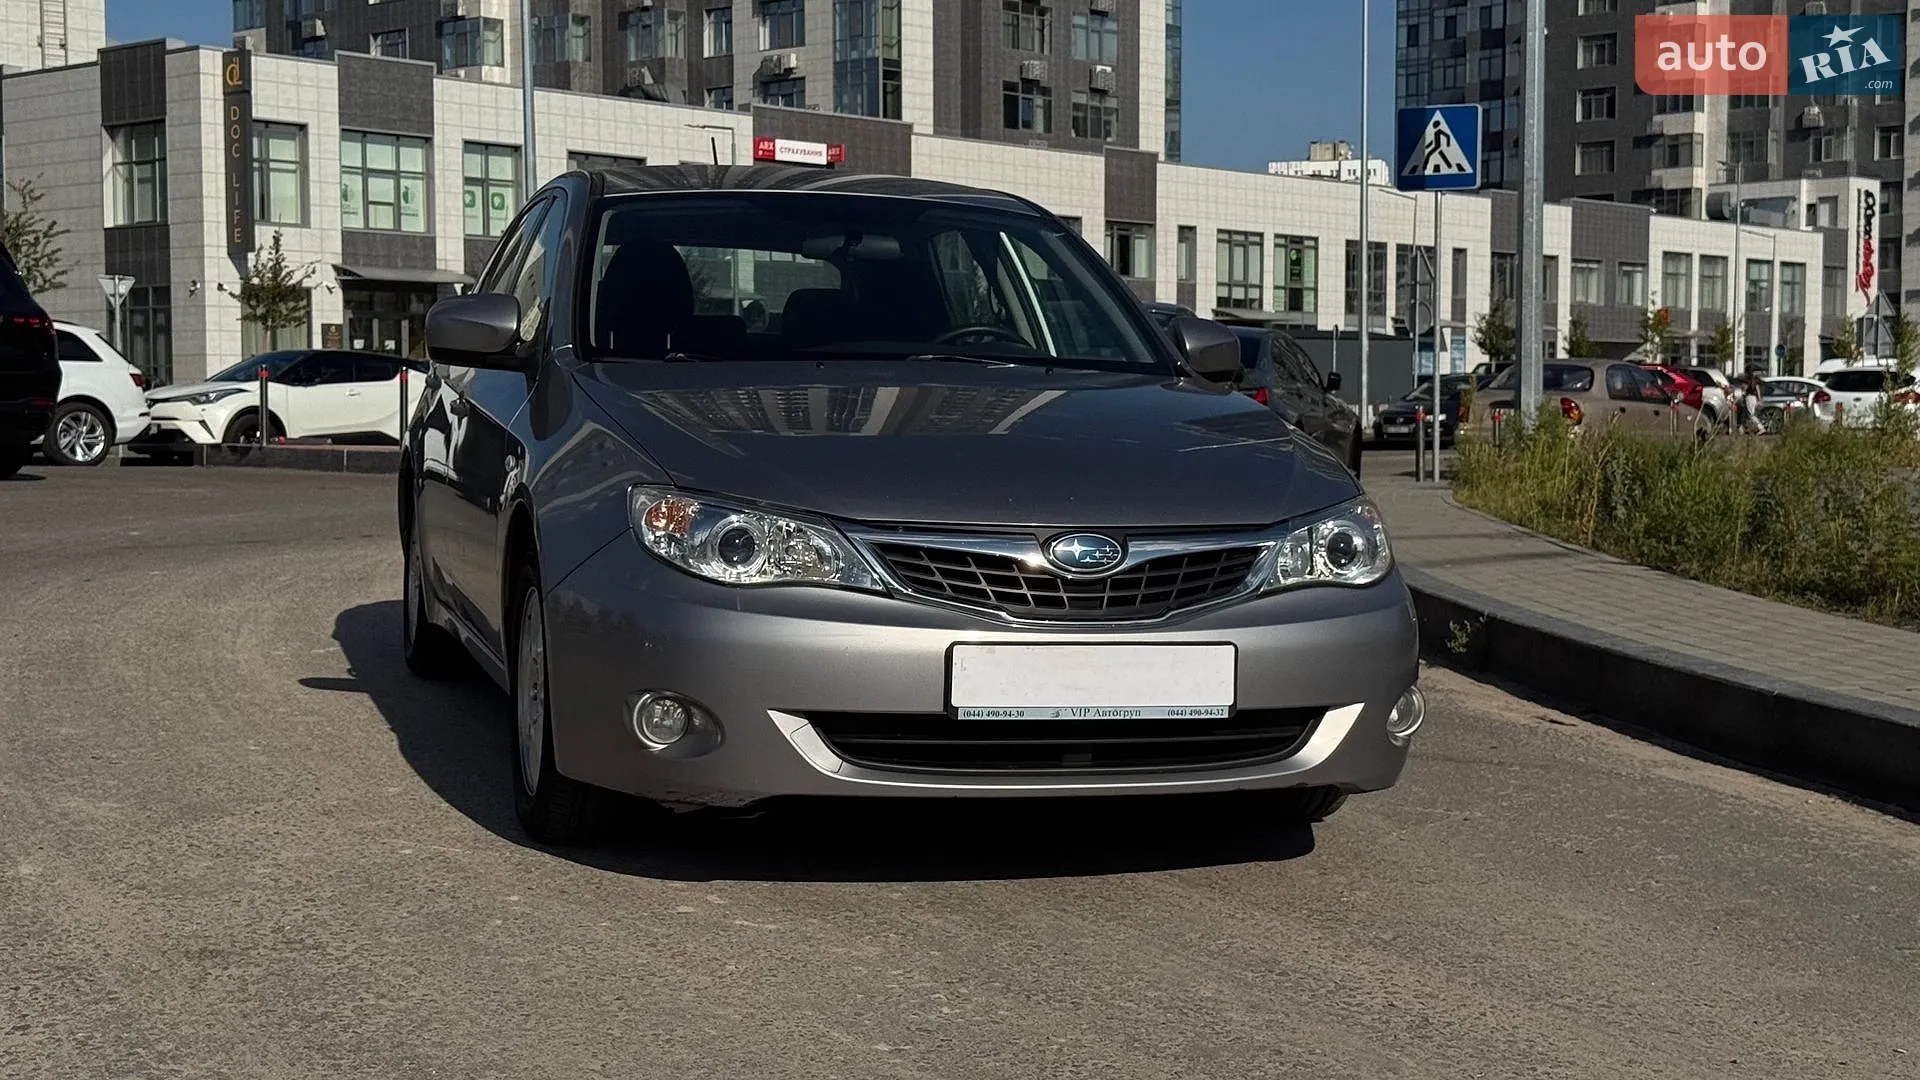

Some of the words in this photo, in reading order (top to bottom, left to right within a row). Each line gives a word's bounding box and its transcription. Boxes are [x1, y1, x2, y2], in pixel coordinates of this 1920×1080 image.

[230, 106, 241, 158] DOC
[231, 172, 242, 243] LIFE
[963, 710, 984, 719] (044)
[986, 710, 1025, 718] 490-94-30
[1070, 708, 1091, 717] VIP
[1093, 708, 1142, 719] Автогруп
[1167, 708, 1187, 718] (044)
[1188, 708, 1224, 717] 490-94-32
